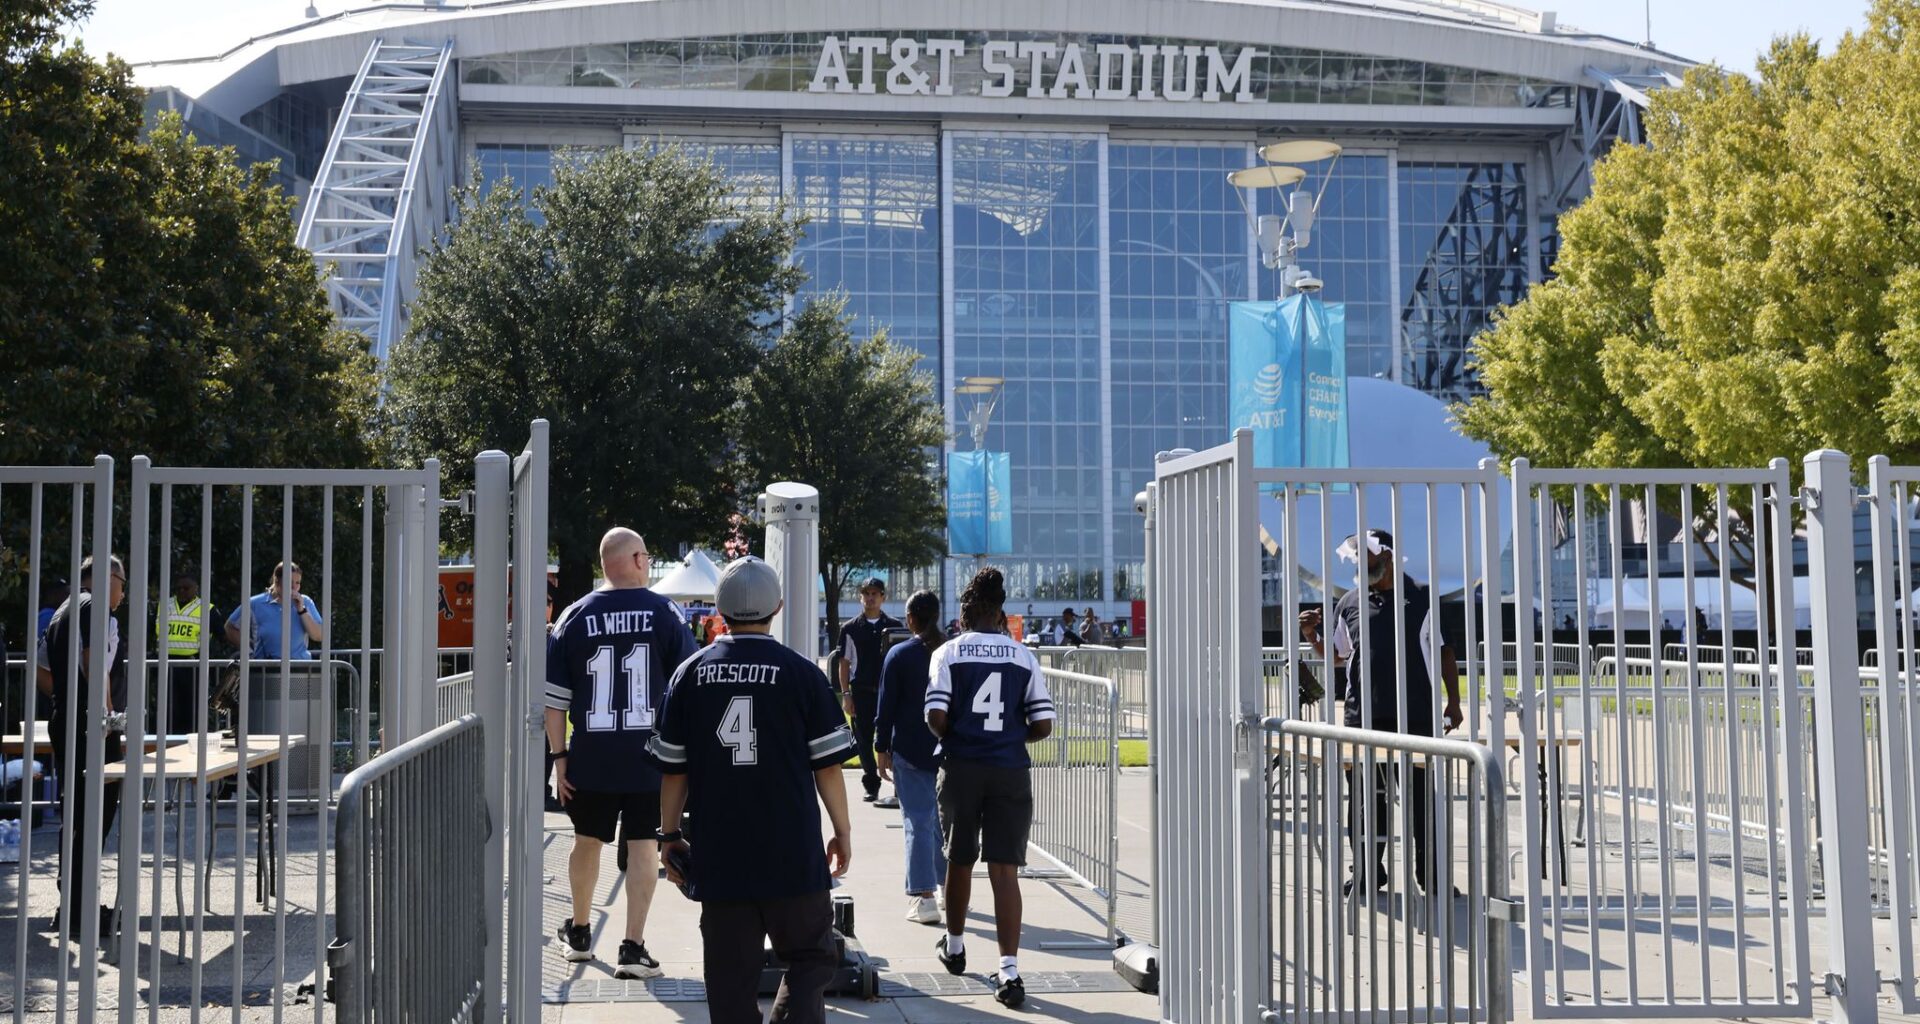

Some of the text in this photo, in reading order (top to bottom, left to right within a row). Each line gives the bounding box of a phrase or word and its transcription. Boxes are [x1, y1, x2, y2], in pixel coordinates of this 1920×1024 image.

[808, 36, 1257, 103] AT&T STADIUM
[1249, 408, 1287, 430] AT&T
[168, 623, 193, 637] LICE
[958, 644, 1018, 658] PRESCOTT
[586, 642, 656, 732] 11
[696, 663, 780, 686] PRESCOTT
[972, 671, 1005, 732] 4
[716, 695, 758, 766] 4
